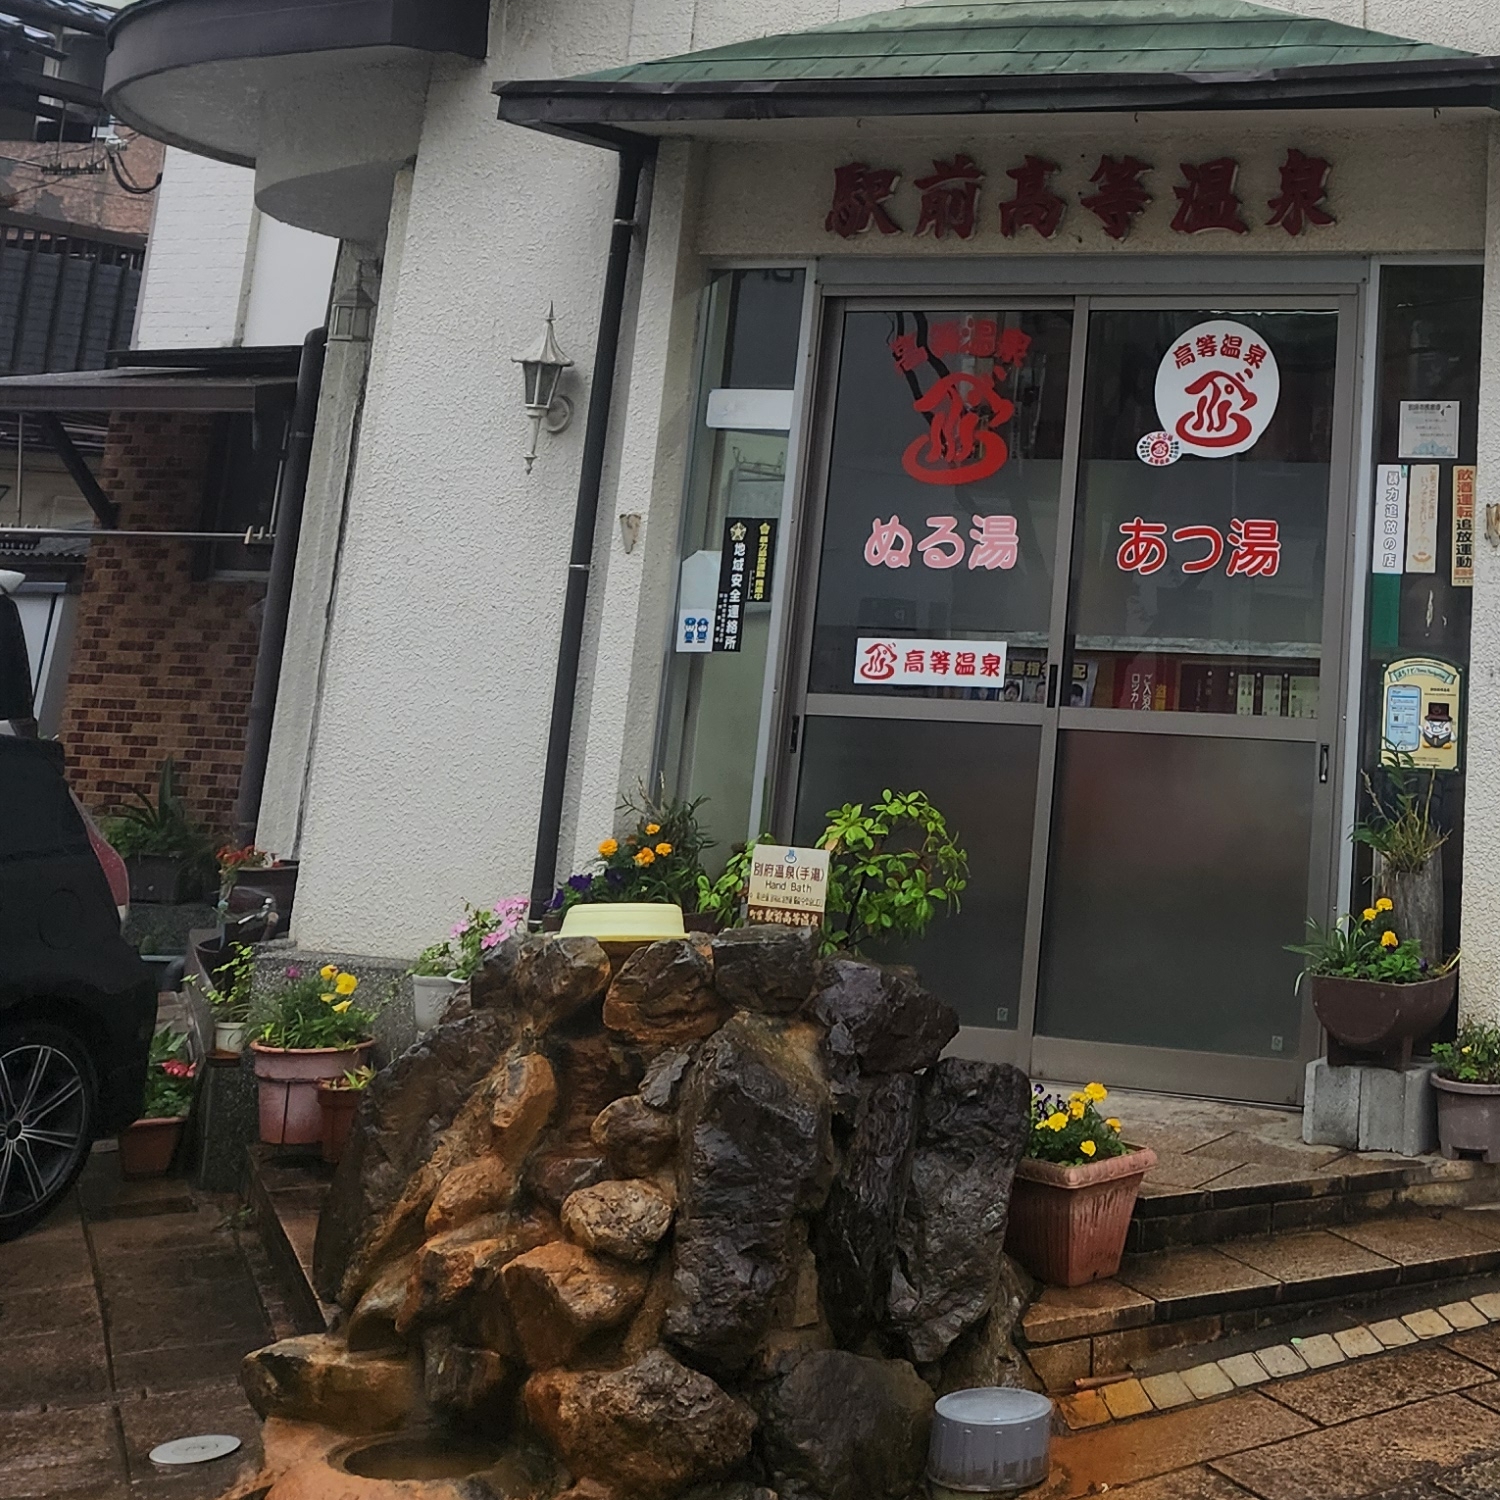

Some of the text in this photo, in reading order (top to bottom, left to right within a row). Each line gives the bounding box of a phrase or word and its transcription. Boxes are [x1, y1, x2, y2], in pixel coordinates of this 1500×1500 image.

[825, 149, 1337, 240] 駅前高等温泉
[1172, 334, 1267, 370] 高等温泉
[864, 514, 1019, 571] ぬる湯
[1117, 516, 1282, 578] あつ湯
[1382, 471, 1400, 568] 暴力追放の店
[724, 542, 746, 650] 地域安全連絡所
[904, 650, 1002, 678] 高等温泉
[753, 862, 824, 882] 別府温泉(手湯)
[765, 881, 812, 893] Hand Bath
